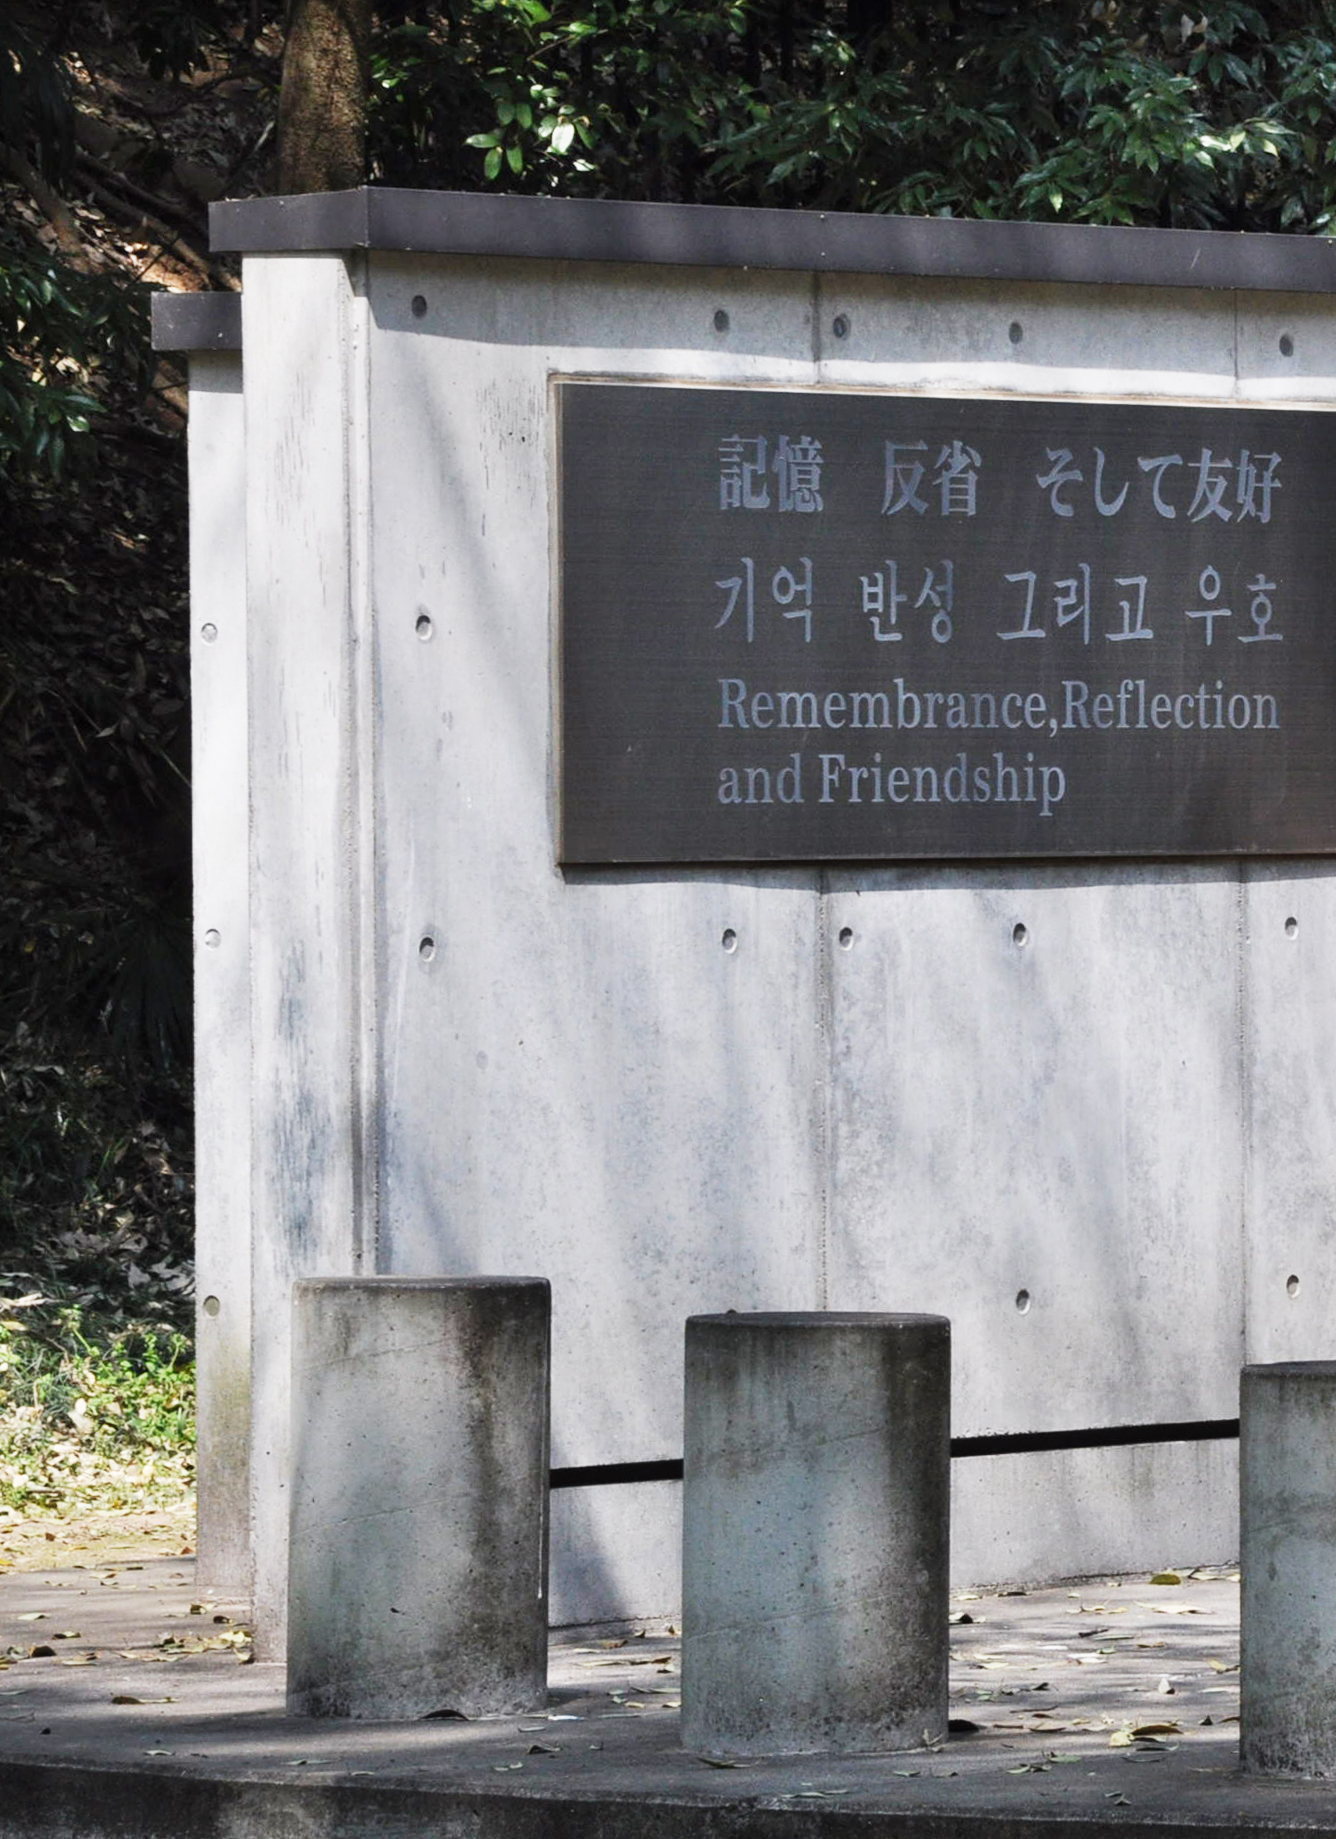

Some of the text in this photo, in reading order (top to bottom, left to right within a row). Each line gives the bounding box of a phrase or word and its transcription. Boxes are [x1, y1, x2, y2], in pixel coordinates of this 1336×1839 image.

[717, 434, 1283, 524] 記憶 反省 そして友好
[714, 556, 1284, 646] 기억 반성 그리고 우호
[717, 751, 1067, 817] and Friendship
